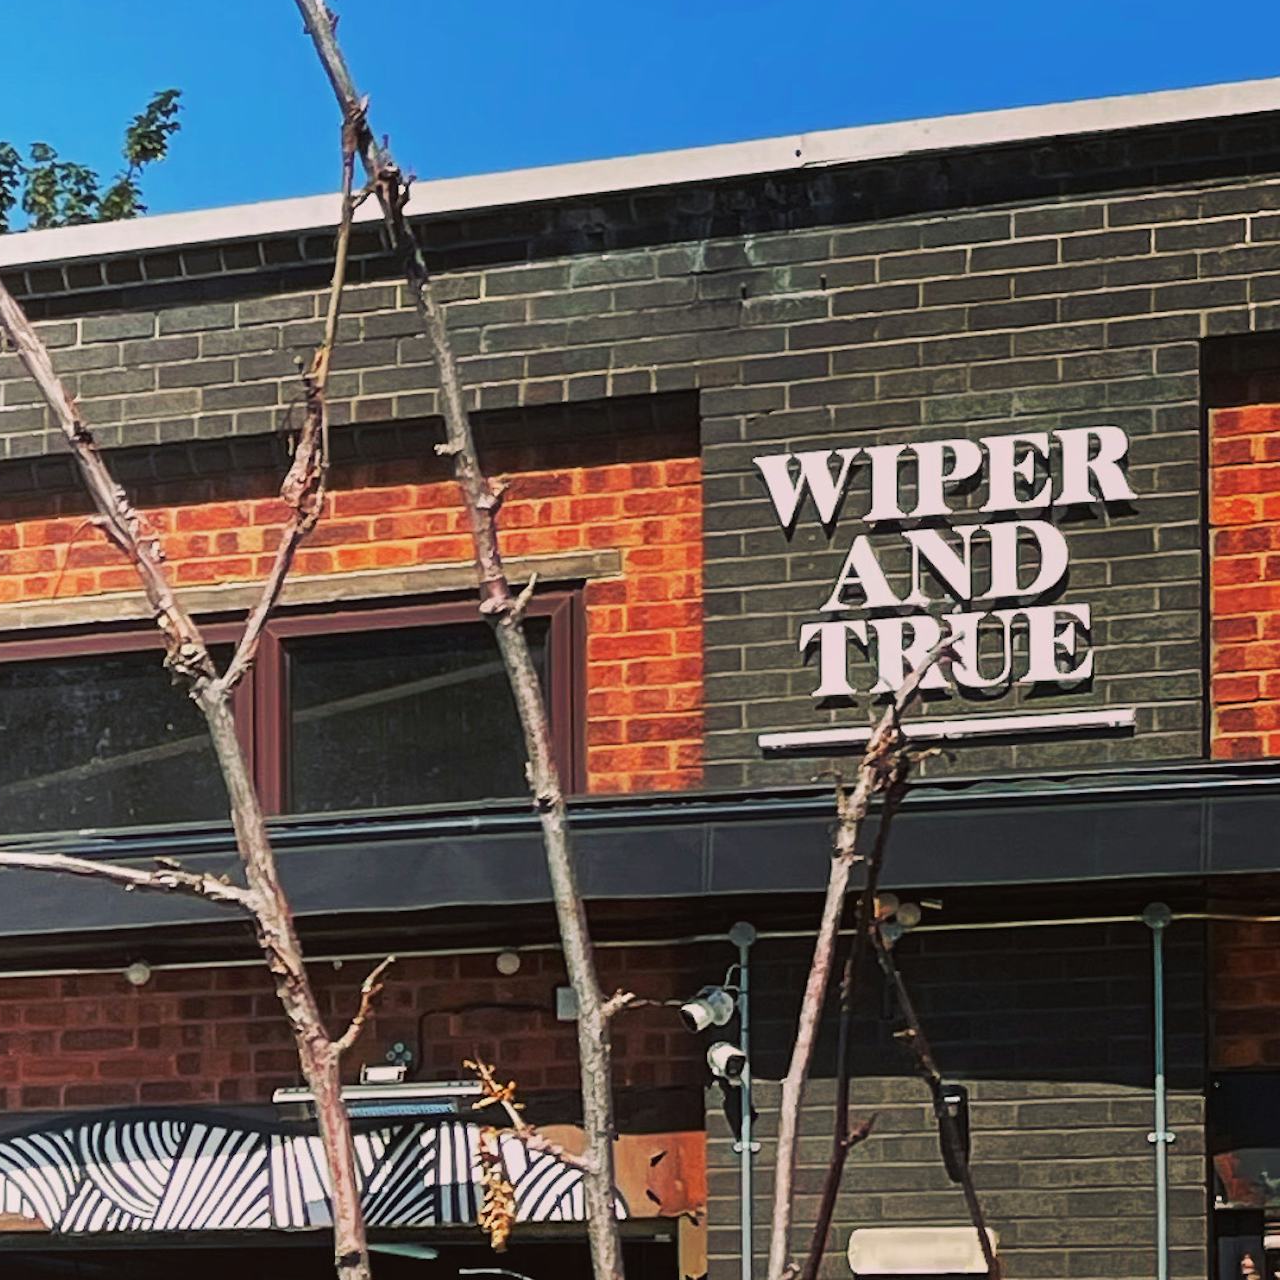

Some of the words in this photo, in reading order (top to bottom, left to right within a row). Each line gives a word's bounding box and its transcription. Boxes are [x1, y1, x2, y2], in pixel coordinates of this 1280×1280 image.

[752, 425, 1138, 528] WIPER
[819, 519, 1069, 613] AND
[799, 602, 1094, 698] TRUE
